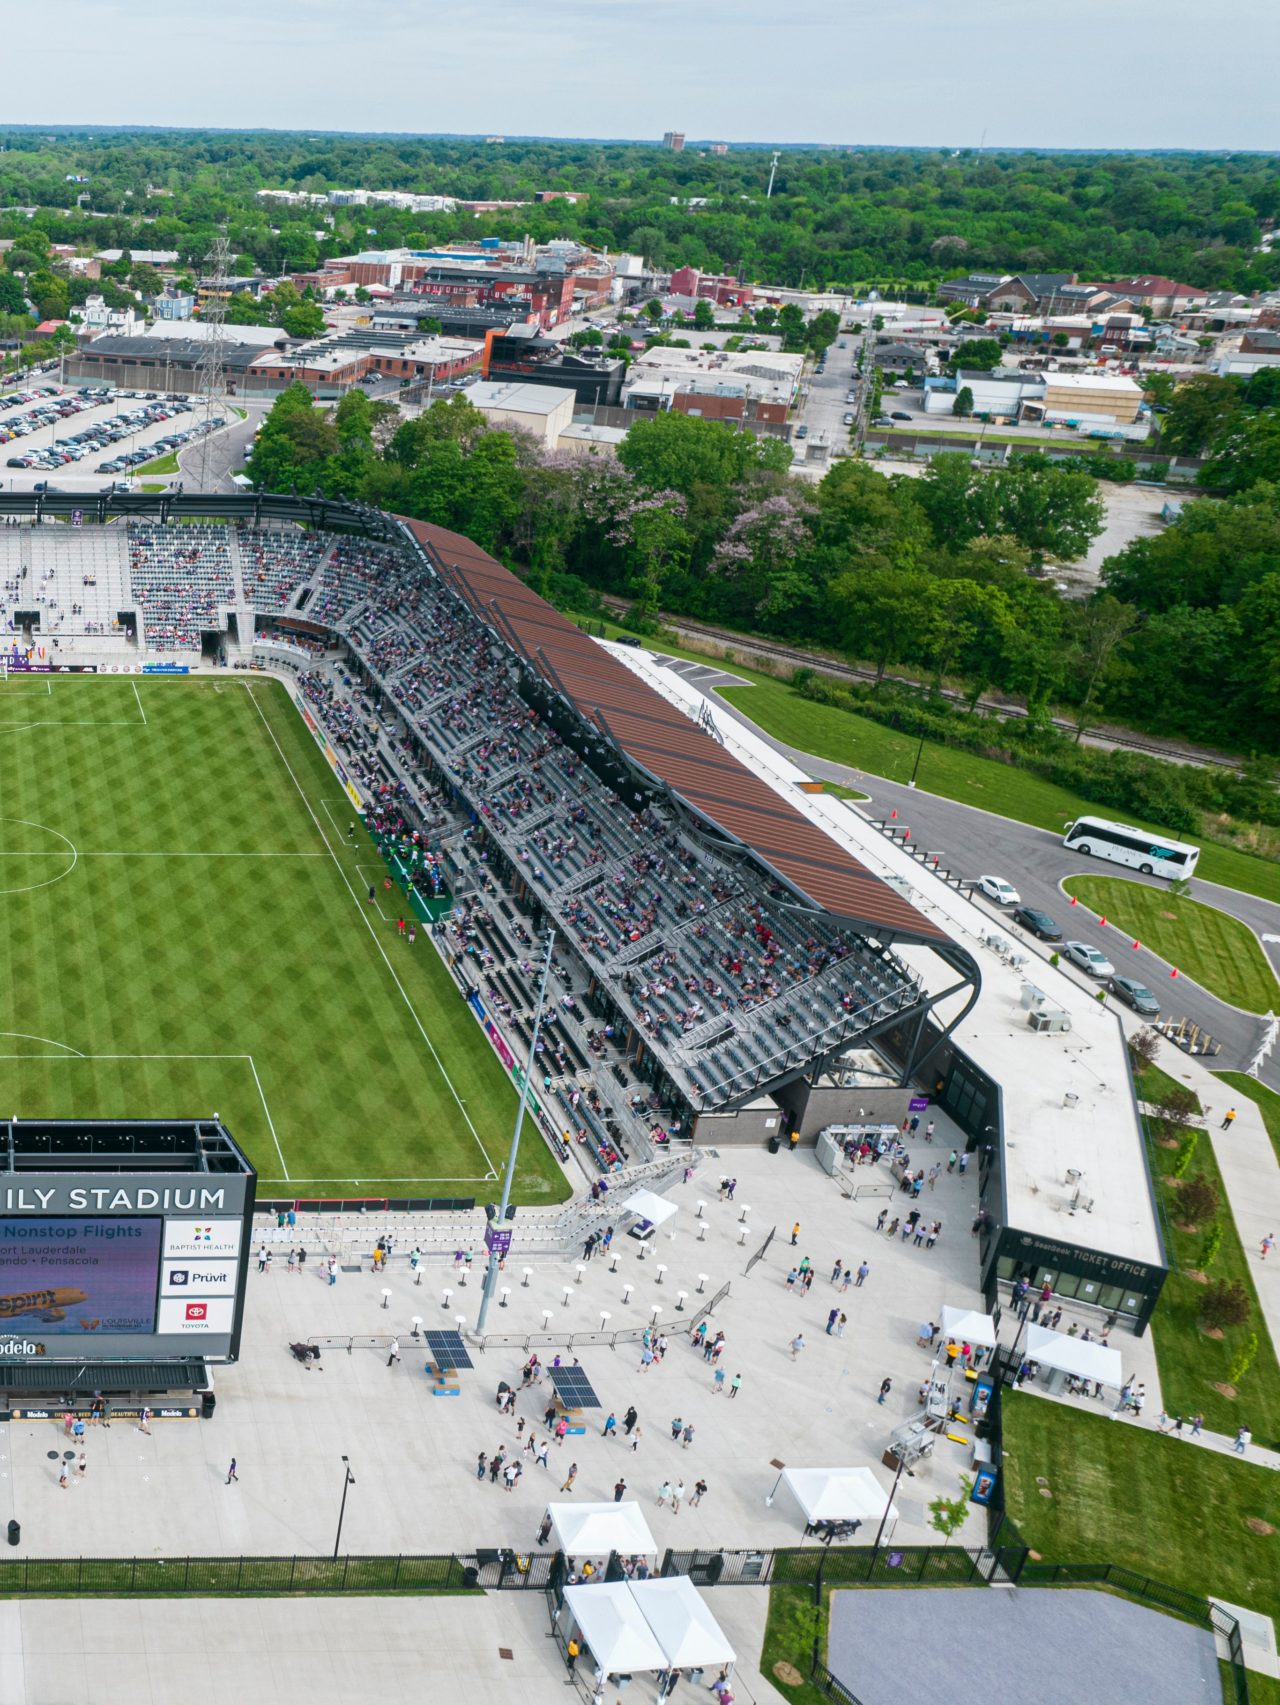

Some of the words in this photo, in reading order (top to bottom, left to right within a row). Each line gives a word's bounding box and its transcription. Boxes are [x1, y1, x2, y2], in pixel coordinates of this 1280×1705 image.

[69, 1188, 225, 1209] STADIUM
[4, 1225, 78, 1240] Nonstop
[84, 1225, 143, 1239] Flights
[22, 1246, 87, 1255] Lauderdale
[41, 1256, 99, 1266] Pensacola
[1073, 1249, 1109, 1266] TICKET
[1110, 1260, 1148, 1277] OFFICE
[192, 1272, 227, 1282] Prüvit
[27, 1410, 48, 1418] Modelo
